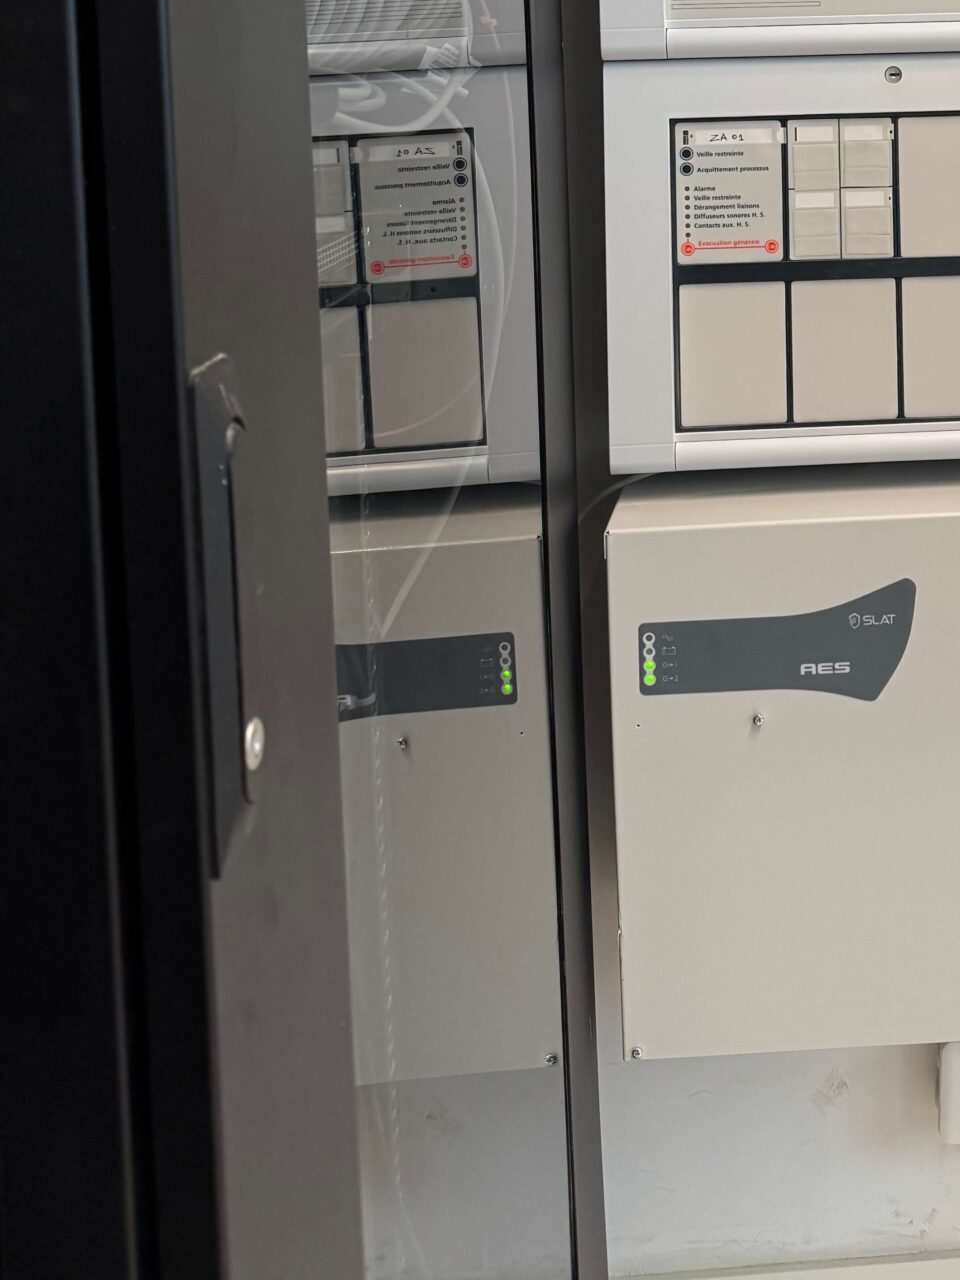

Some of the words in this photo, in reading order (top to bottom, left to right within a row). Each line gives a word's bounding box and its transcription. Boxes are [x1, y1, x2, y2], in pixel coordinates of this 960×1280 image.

[709, 133, 727, 142] ZA
[863, 615, 896, 626] SLAT
[800, 662, 850, 675] AES
